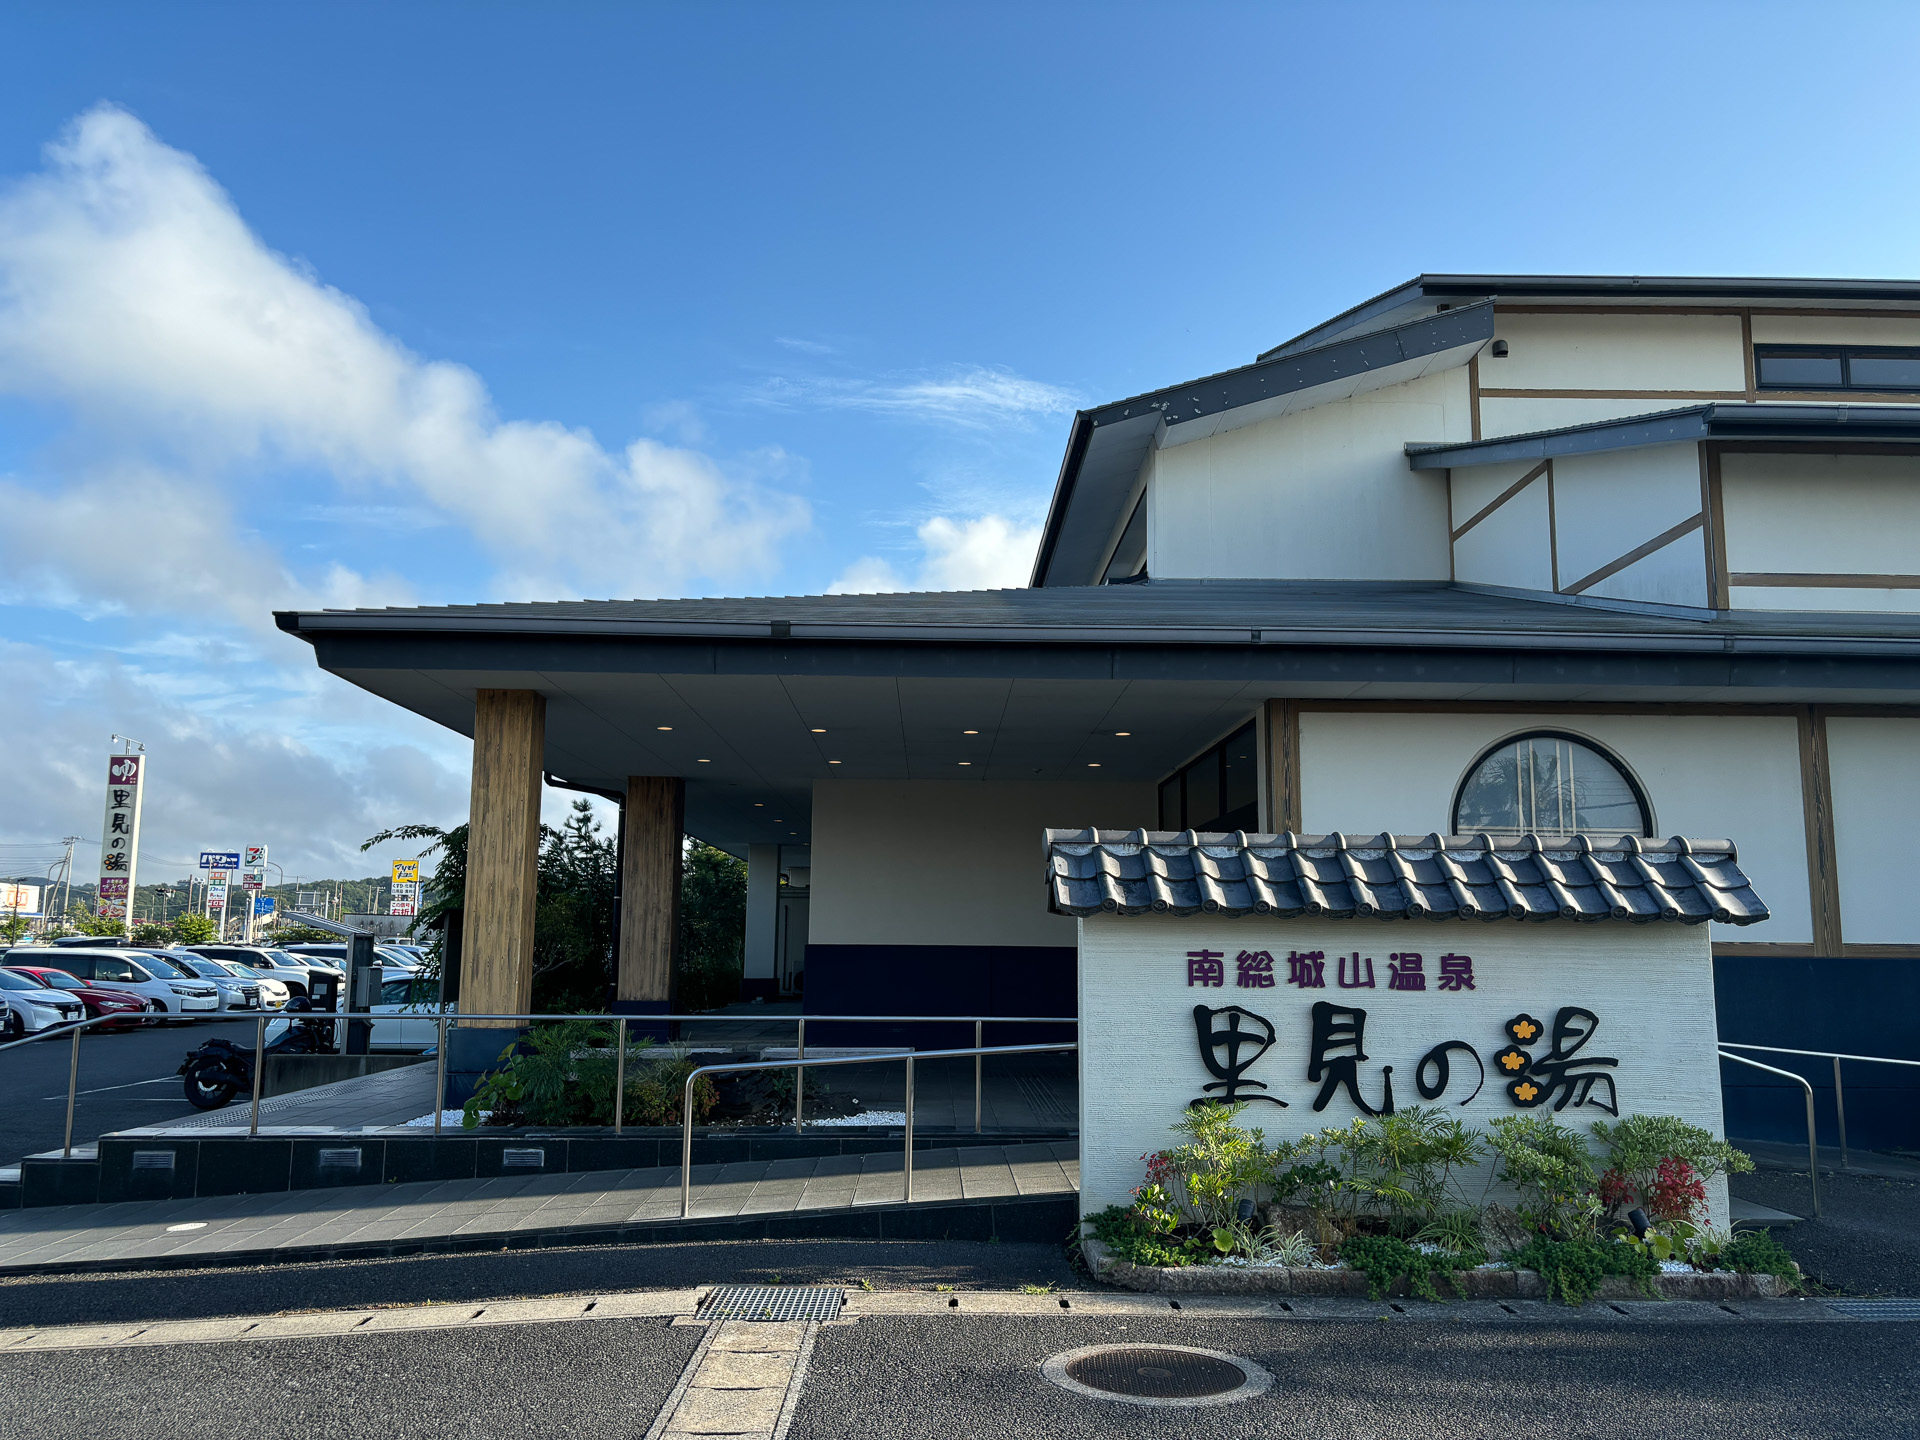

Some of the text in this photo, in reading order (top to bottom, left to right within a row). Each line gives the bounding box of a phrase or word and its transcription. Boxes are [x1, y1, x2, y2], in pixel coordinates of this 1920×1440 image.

[112, 759, 136, 782] ゆ
[104, 789, 131, 872] 里見の湯
[201, 855, 237, 863] パワー
[1186, 949, 1477, 992] 南総城山温泉
[1190, 1001, 1619, 1118] 里見の湯
